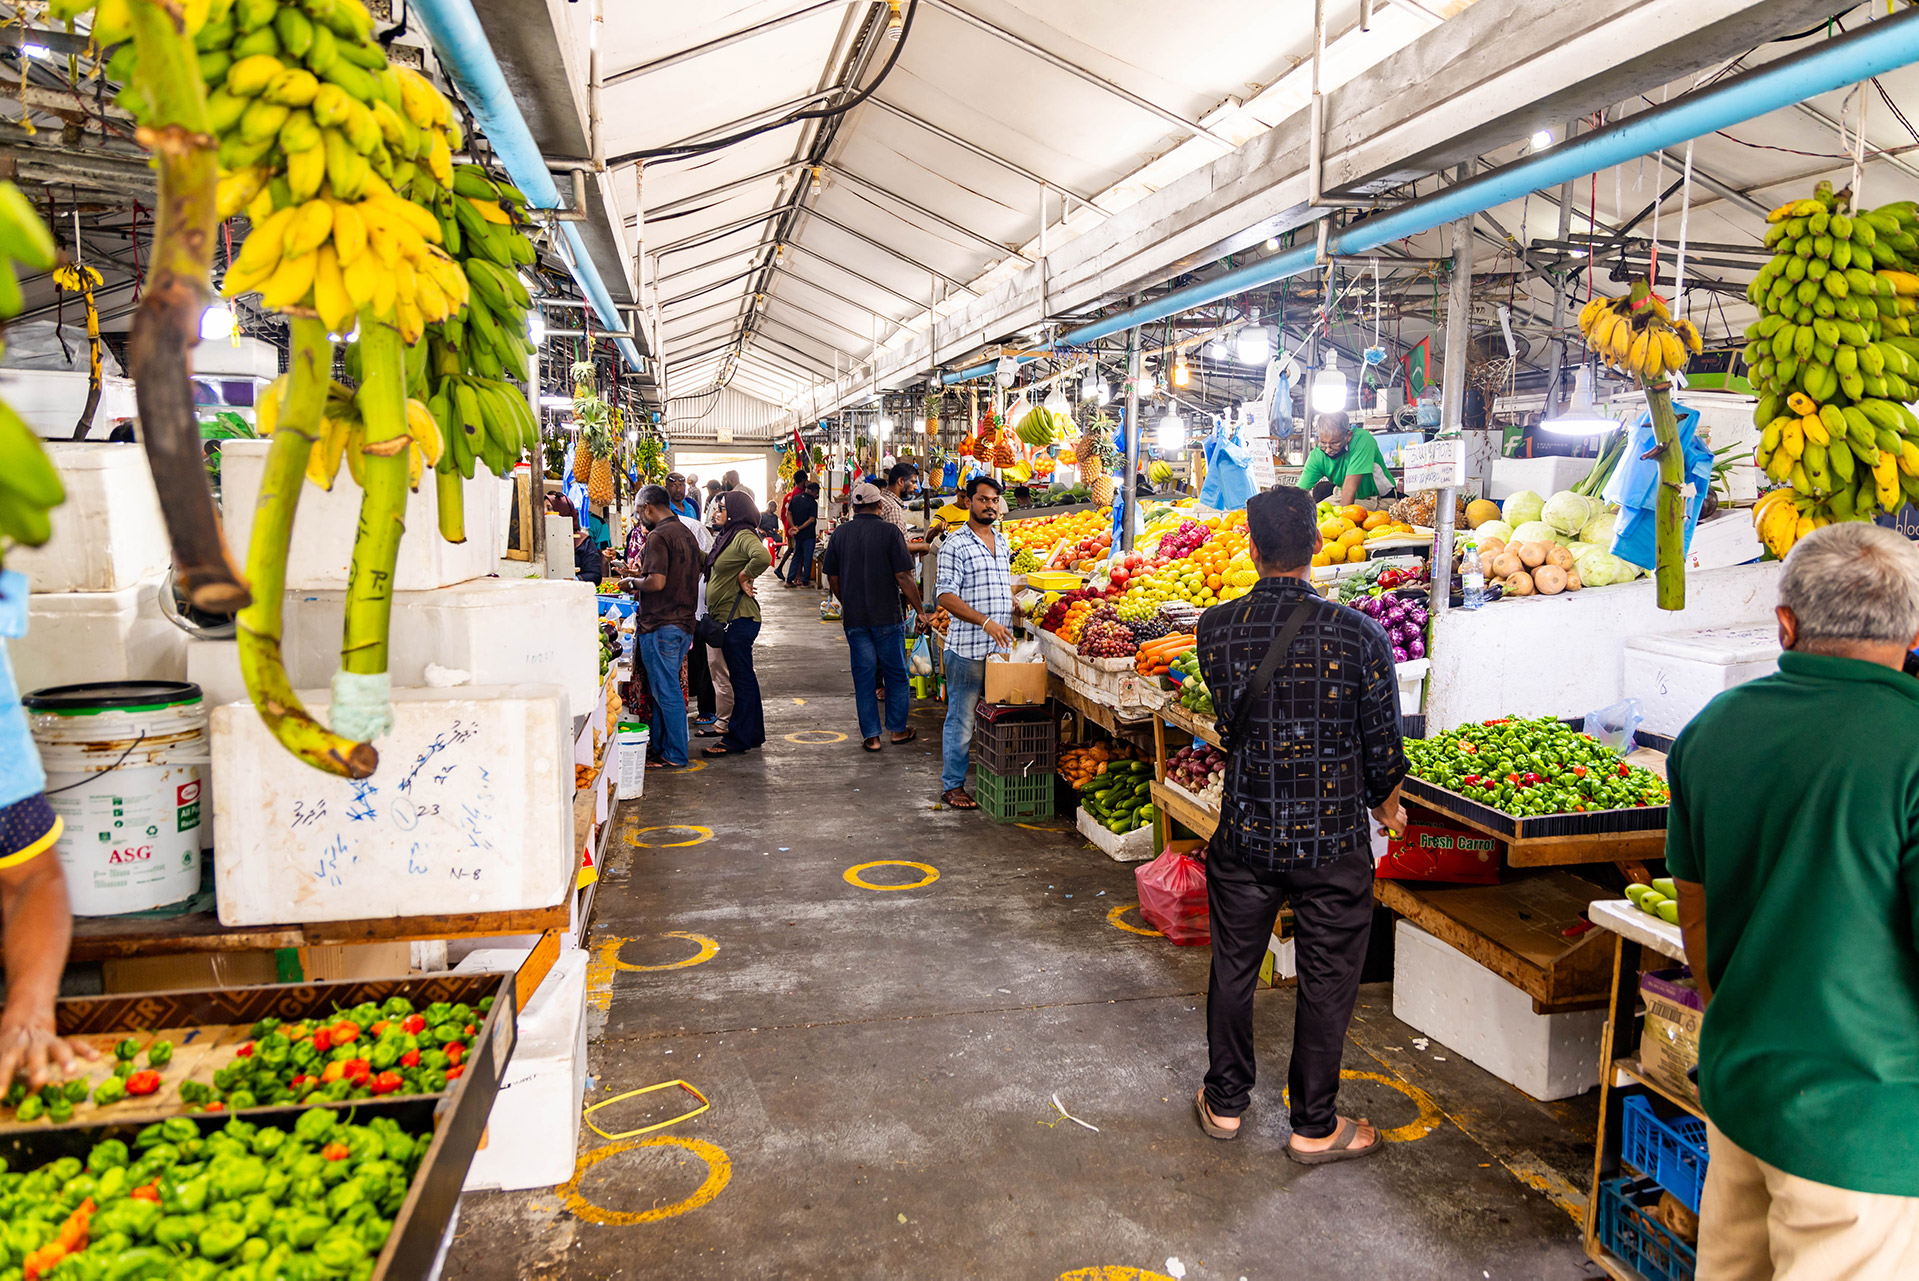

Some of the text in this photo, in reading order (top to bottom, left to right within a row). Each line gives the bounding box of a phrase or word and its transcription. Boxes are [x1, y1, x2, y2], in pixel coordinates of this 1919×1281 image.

[1420, 833, 1495, 851] Fresh Carrot
[108, 845, 152, 864] ASG
